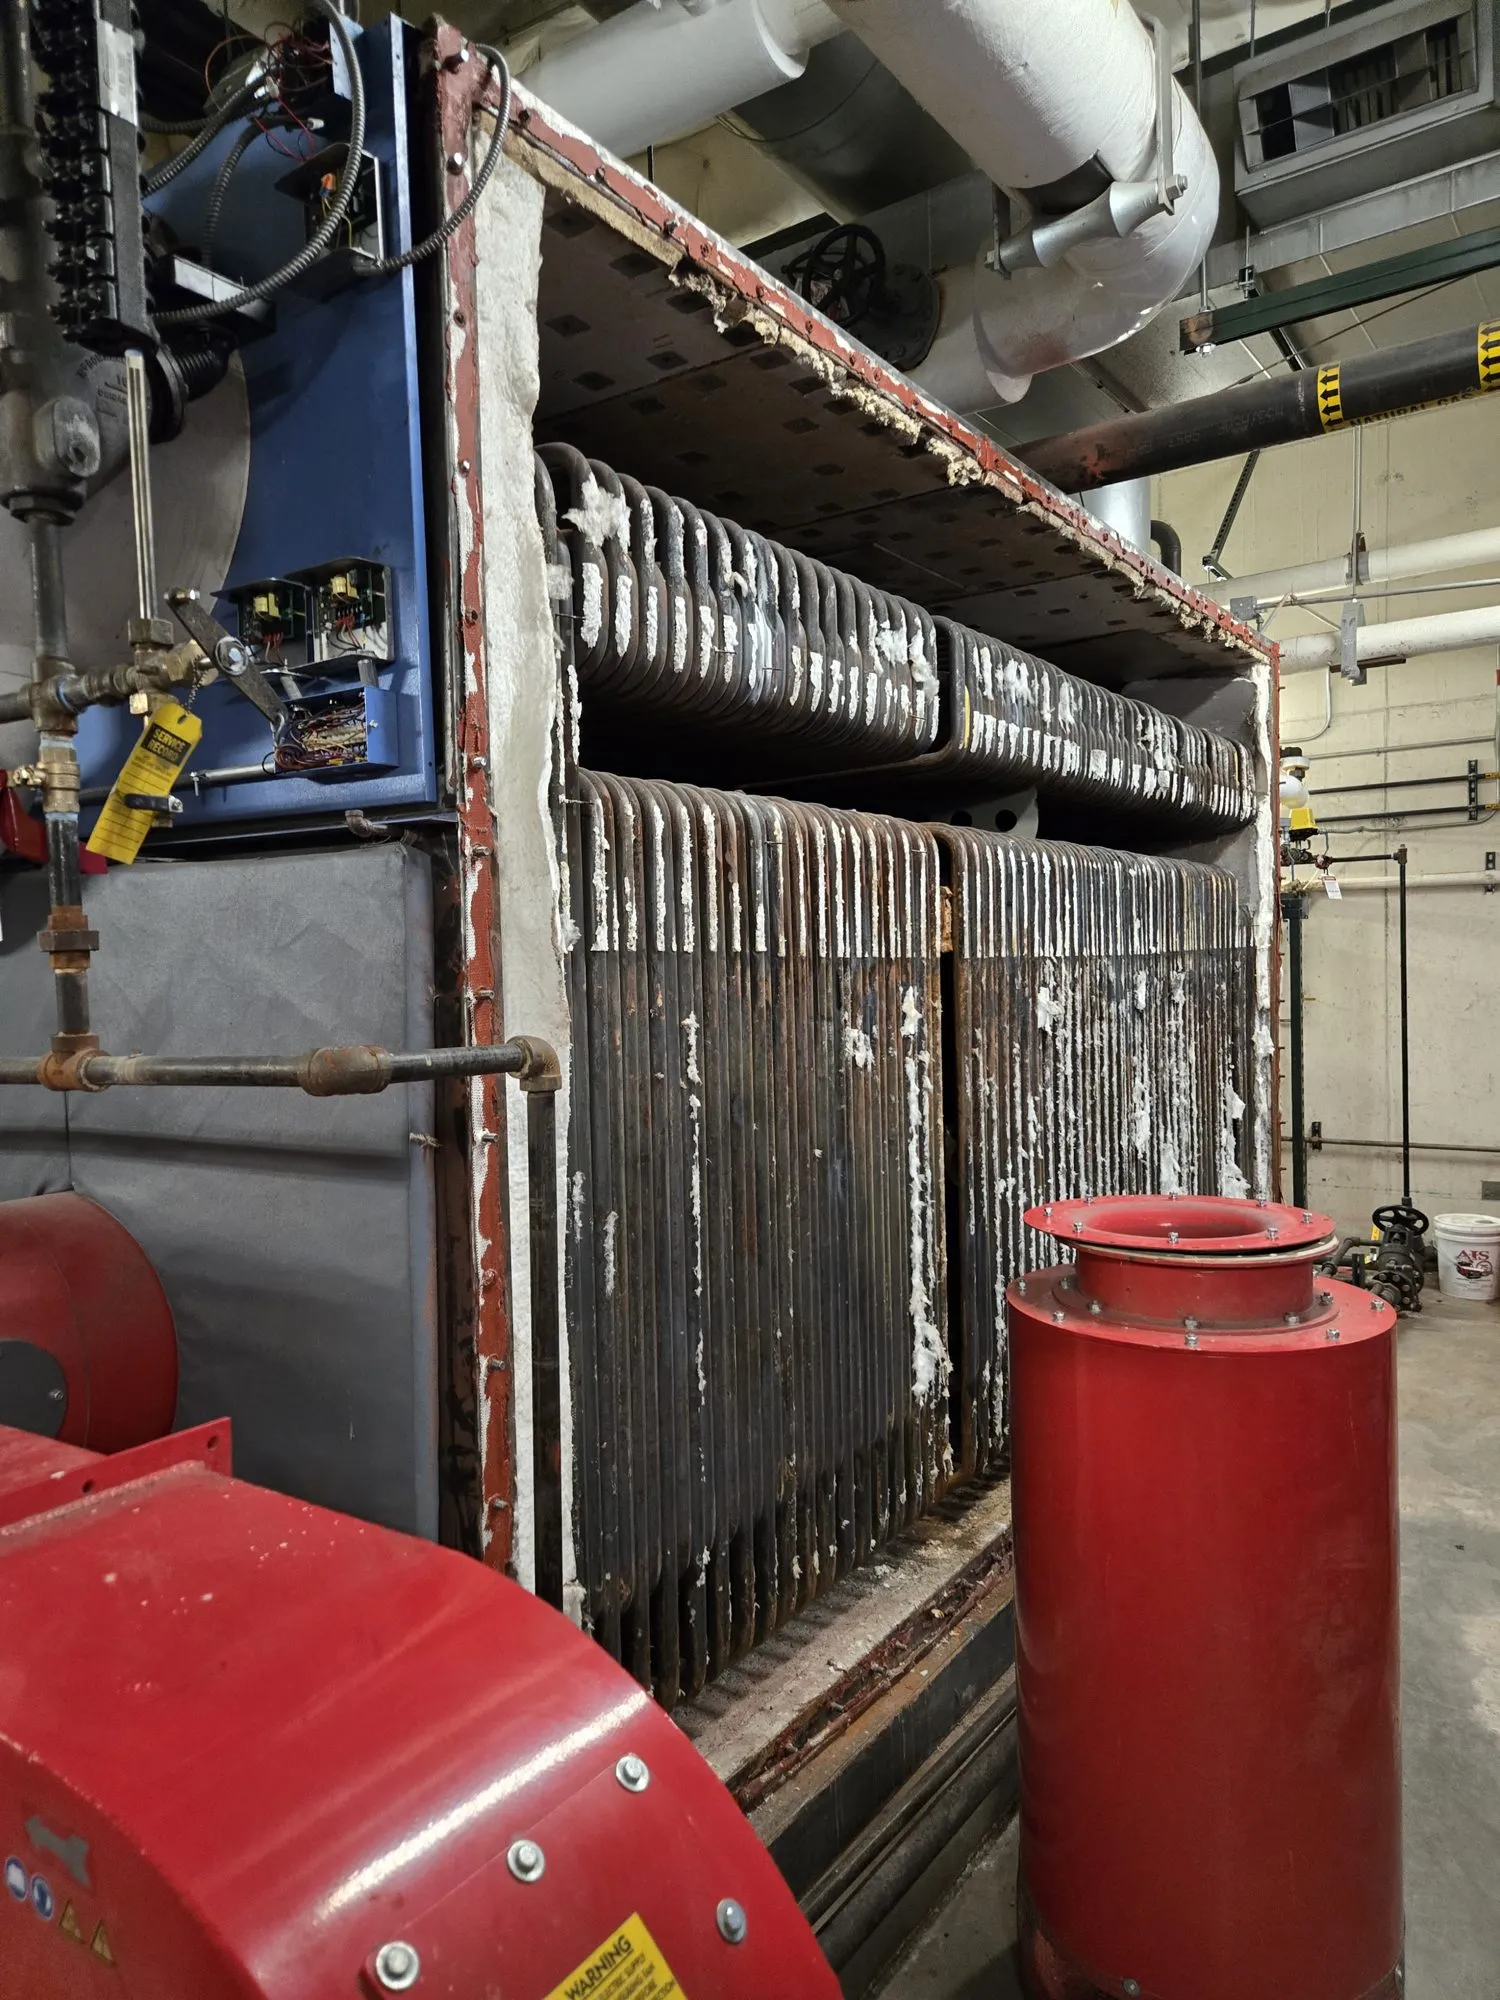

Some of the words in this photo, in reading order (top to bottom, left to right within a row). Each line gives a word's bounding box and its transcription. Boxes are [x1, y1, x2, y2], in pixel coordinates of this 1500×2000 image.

[147, 739, 178, 762] RECORD
[153, 728, 186, 753] SERVICE
[1455, 1250, 1490, 1262] AIS
[564, 1934, 632, 2000] WARNING
